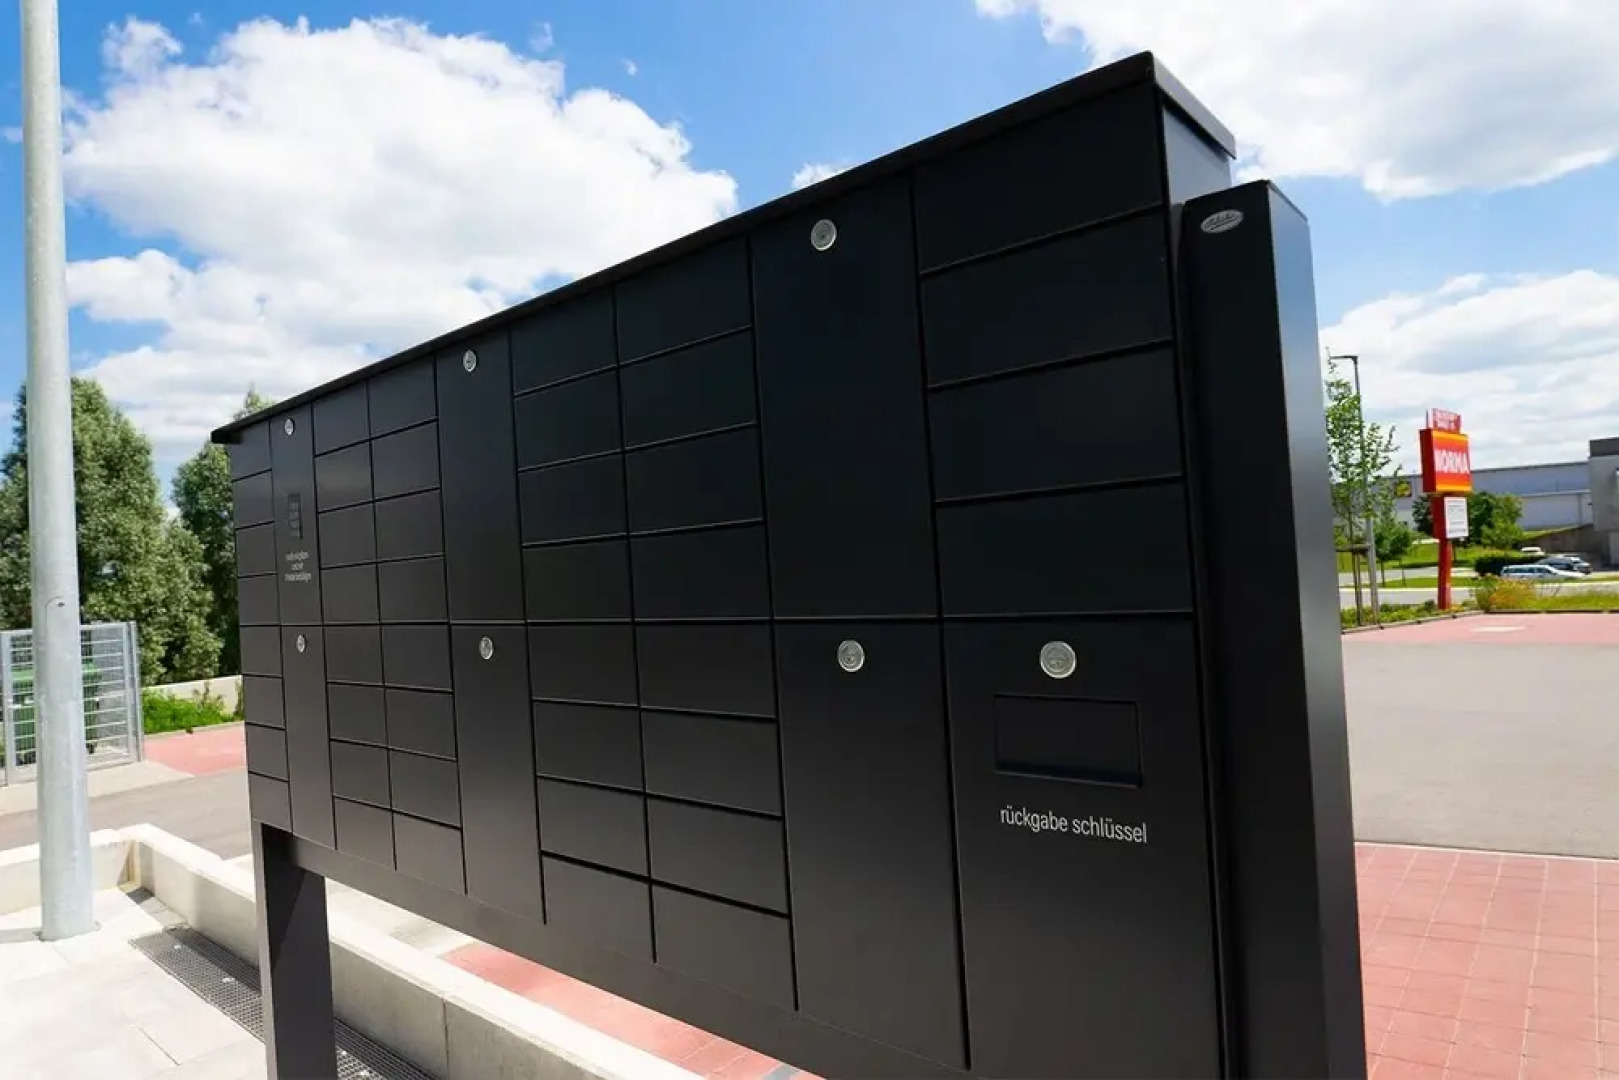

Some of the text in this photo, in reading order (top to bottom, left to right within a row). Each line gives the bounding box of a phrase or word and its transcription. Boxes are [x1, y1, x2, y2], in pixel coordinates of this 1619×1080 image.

[1435, 450, 1469, 473] NORMA
[1000, 804, 1147, 843] rückgabe schlüssel
